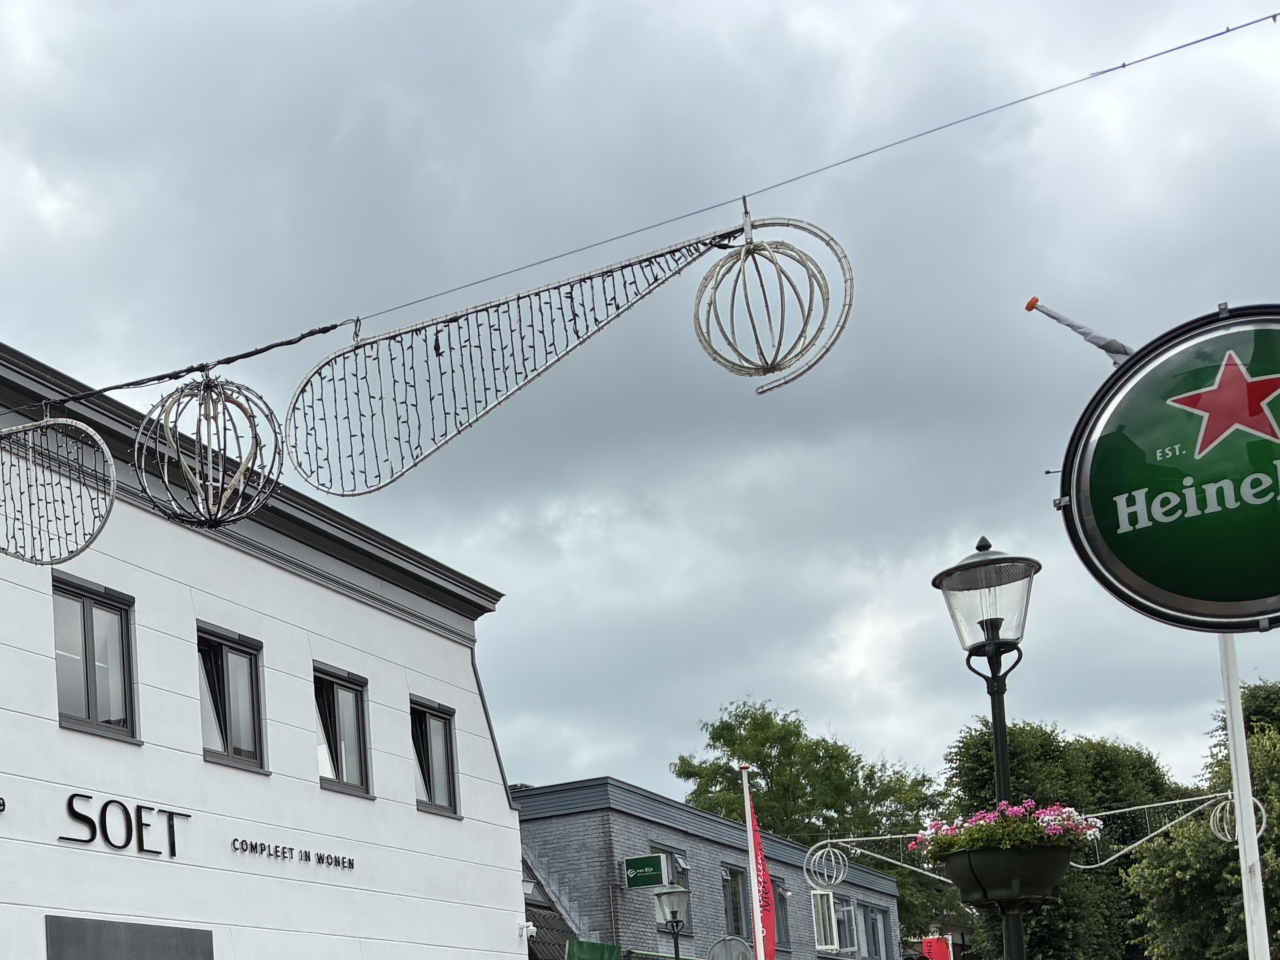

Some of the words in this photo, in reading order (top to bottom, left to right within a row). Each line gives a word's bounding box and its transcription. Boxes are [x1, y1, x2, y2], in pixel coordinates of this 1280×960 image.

[1156, 444, 1186, 460] EST.
[58, 793, 192, 857] SOET
[231, 838, 295, 860] COMPLEET
[299, 850, 311, 862] IN
[316, 852, 355, 870] WONEN
